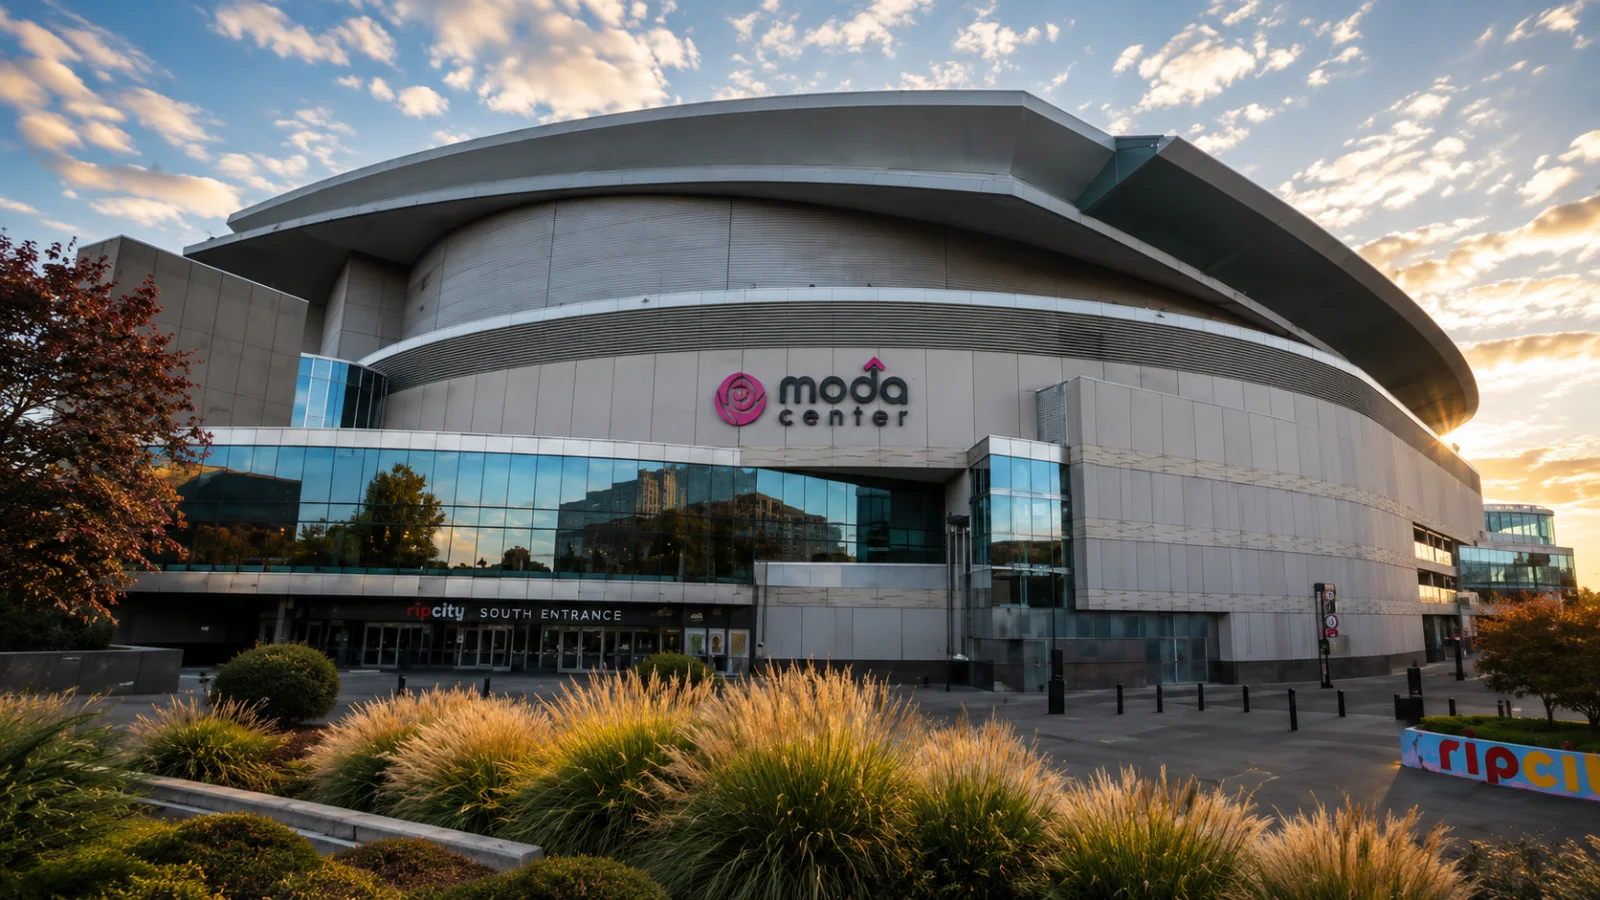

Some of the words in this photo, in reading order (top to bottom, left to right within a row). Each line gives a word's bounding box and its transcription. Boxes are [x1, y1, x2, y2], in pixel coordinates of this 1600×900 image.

[779, 357, 909, 405] moda
[779, 406, 908, 427] center
[480, 607, 532, 619] SOUTH
[541, 609, 622, 621] ENTRANCE
